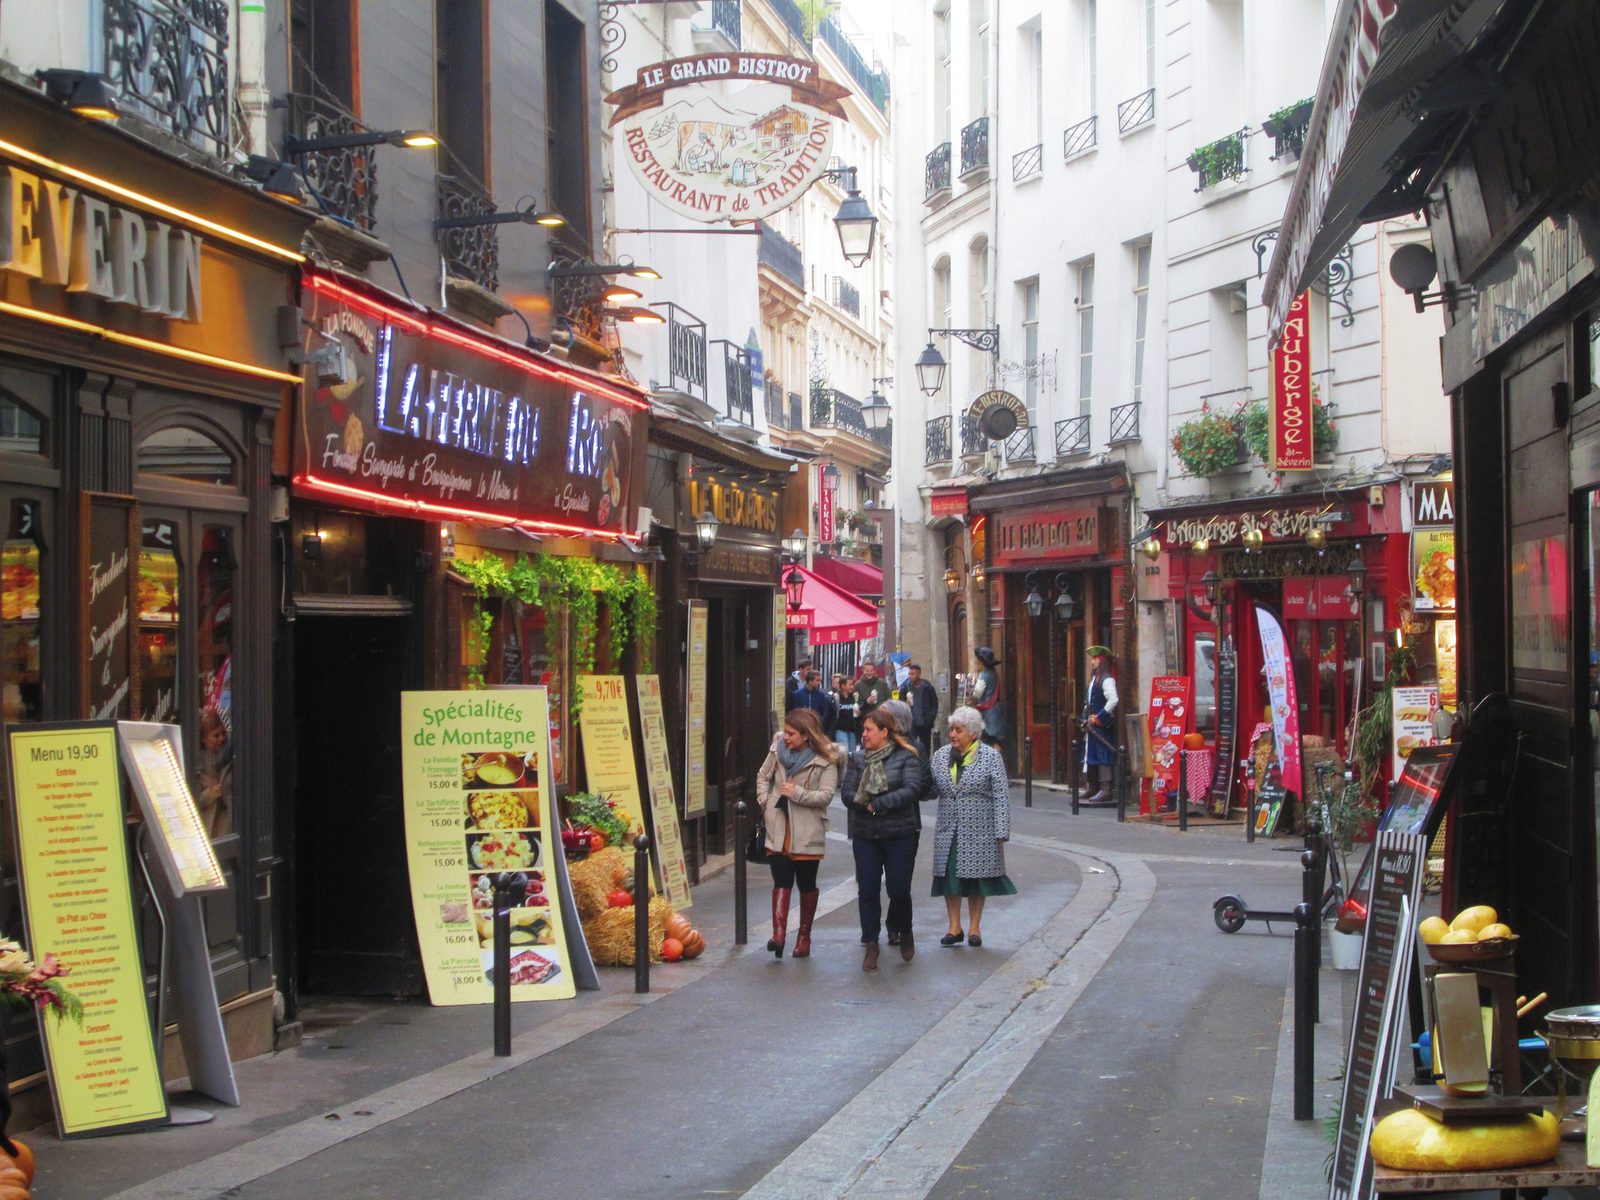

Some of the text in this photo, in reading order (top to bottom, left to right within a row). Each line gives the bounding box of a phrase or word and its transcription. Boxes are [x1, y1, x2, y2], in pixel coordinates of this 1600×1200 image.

[642, 56, 811, 89] LE GRAND BISTROT
[624, 116, 832, 214] RESTAURANT de TRADITION
[3, 165, 203, 324] EVERIN
[341, 311, 375, 354] FONDUE
[981, 390, 1020, 411] BISTROT
[747, 491, 778, 532] PARIS
[1002, 524, 1016, 551] LE
[1019, 520, 1072, 550] BISTROT
[1165, 518, 1238, 546] L'Auberge
[422, 698, 523, 728] Spécialités
[413, 727, 536, 750] de Montagne
[31, 744, 99, 762] Menu 19,90
[423, 755, 458, 764] La Fondue
[452, 780, 459, 789] €
[454, 818, 461, 827] €
[457, 857, 464, 866] €
[468, 935, 475, 943] €
[476, 975, 483, 984] €
